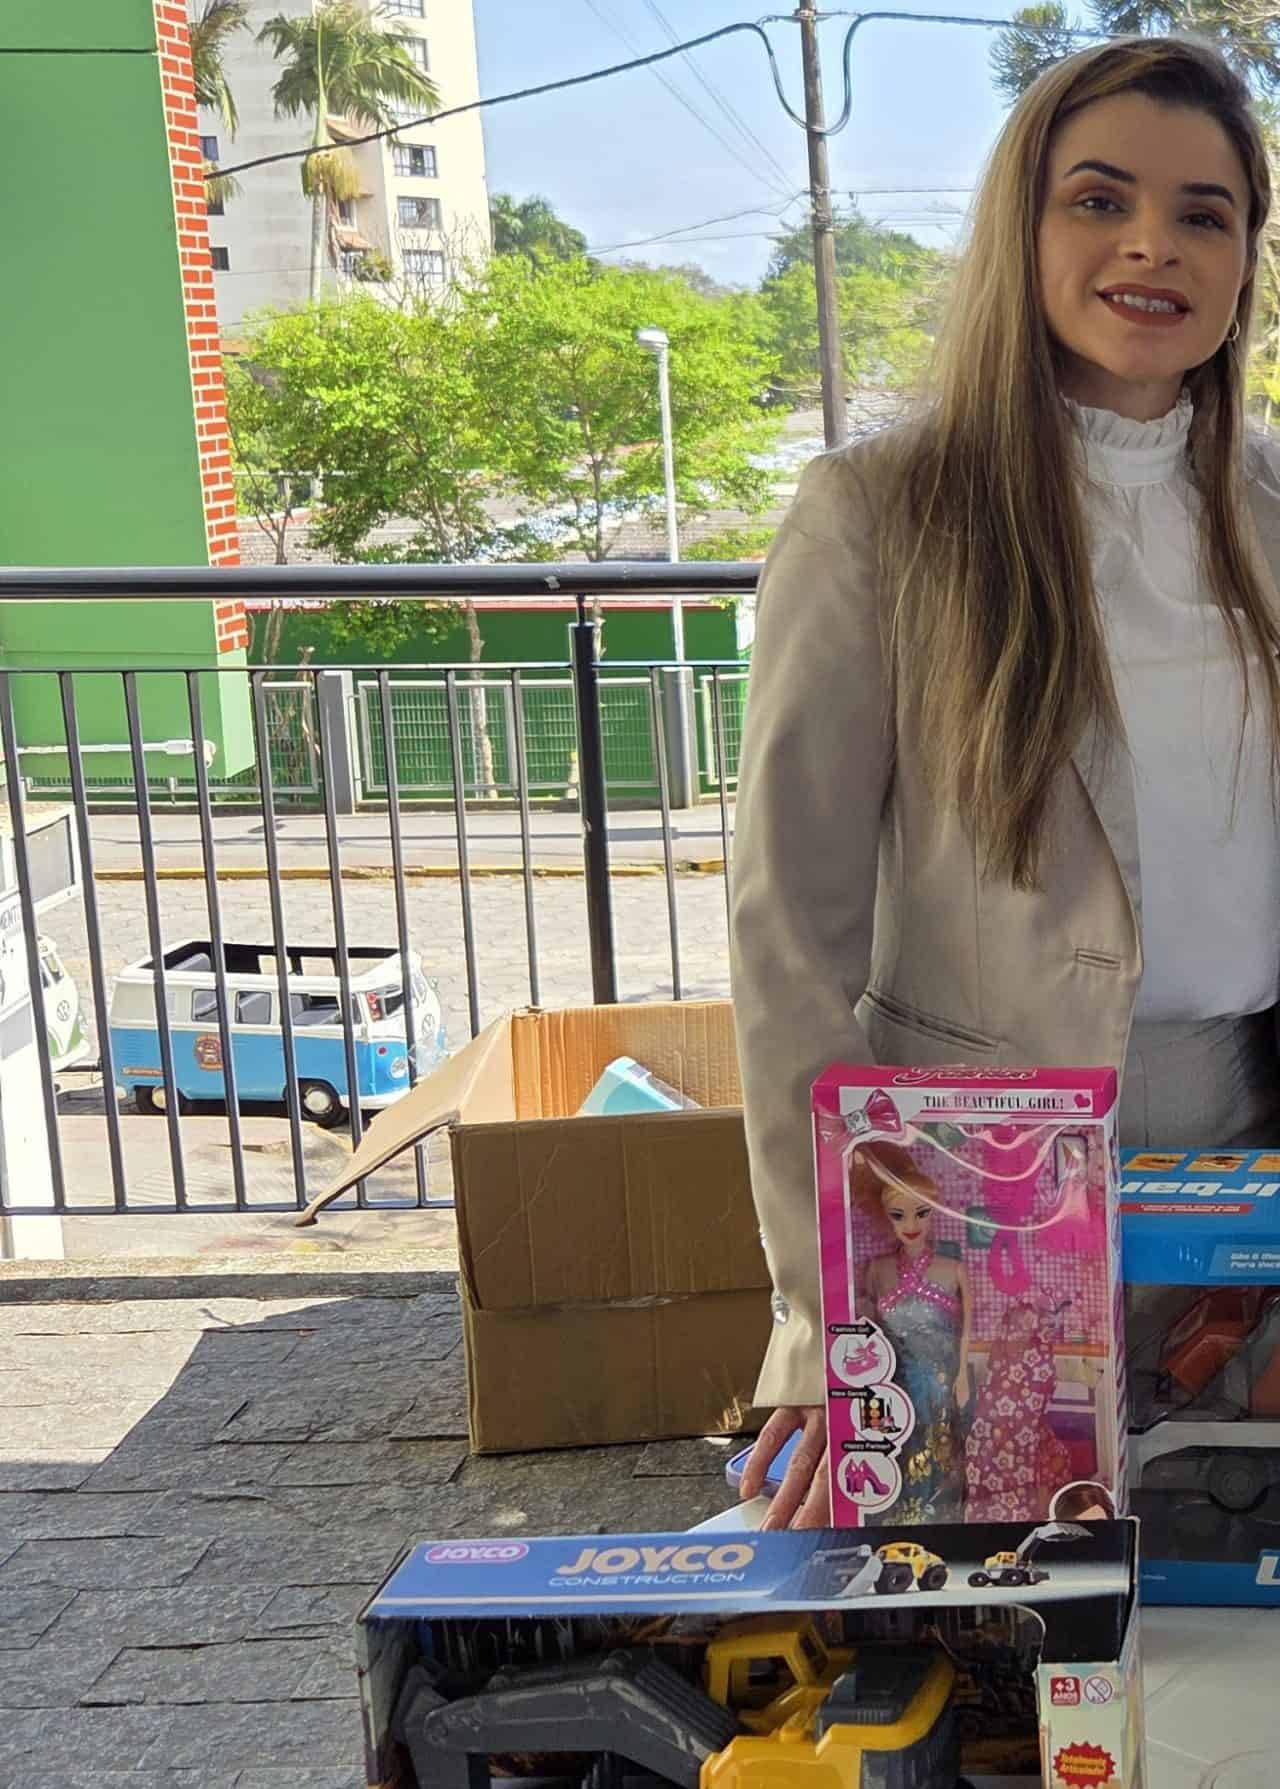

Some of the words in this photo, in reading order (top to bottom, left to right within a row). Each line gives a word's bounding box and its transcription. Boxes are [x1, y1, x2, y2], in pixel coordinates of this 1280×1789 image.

[923, 1096, 950, 1109] THE
[954, 1096, 1024, 1109] BEAUTIFUL
[1028, 1097, 1064, 1110] GIRL!
[549, 1573, 745, 1587] CONSTRUCTION
